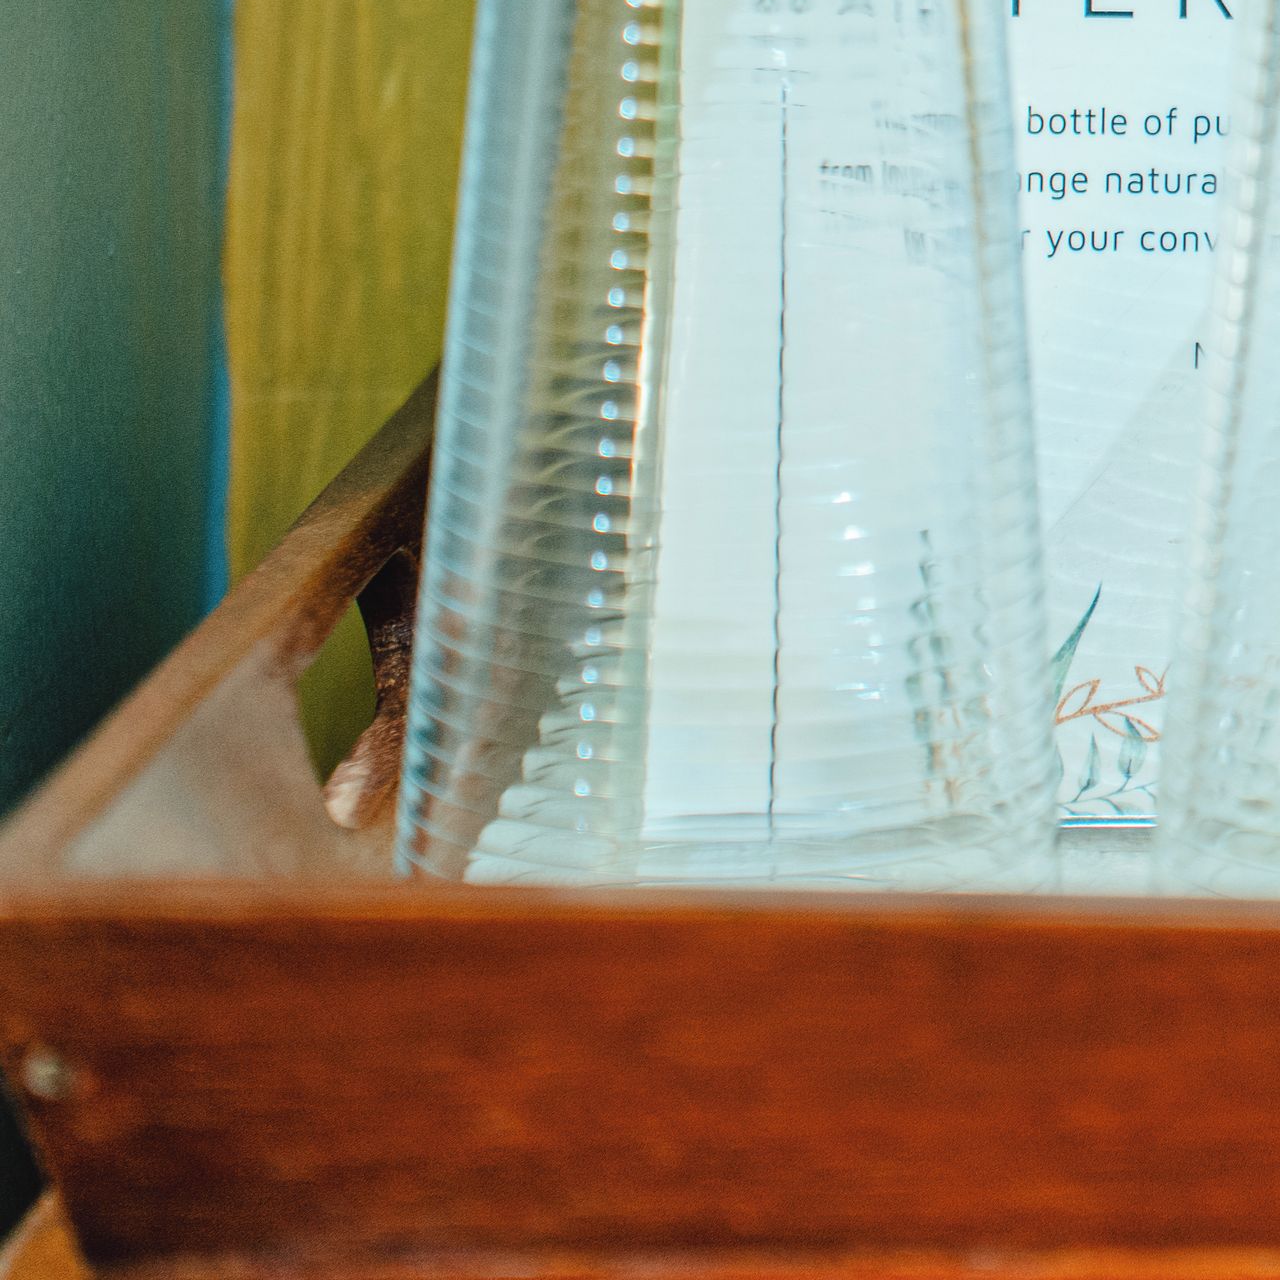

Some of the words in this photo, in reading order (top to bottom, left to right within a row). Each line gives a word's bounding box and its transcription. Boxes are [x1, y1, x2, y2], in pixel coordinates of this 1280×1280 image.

[1026, 105, 1128, 136] bottle
[1143, 106, 1178, 136] of
[1193, 114, 1231, 144] pu
[1018, 170, 1089, 200] nge
[1104, 167, 1219, 195] natura
[1045, 229, 1126, 259] your
